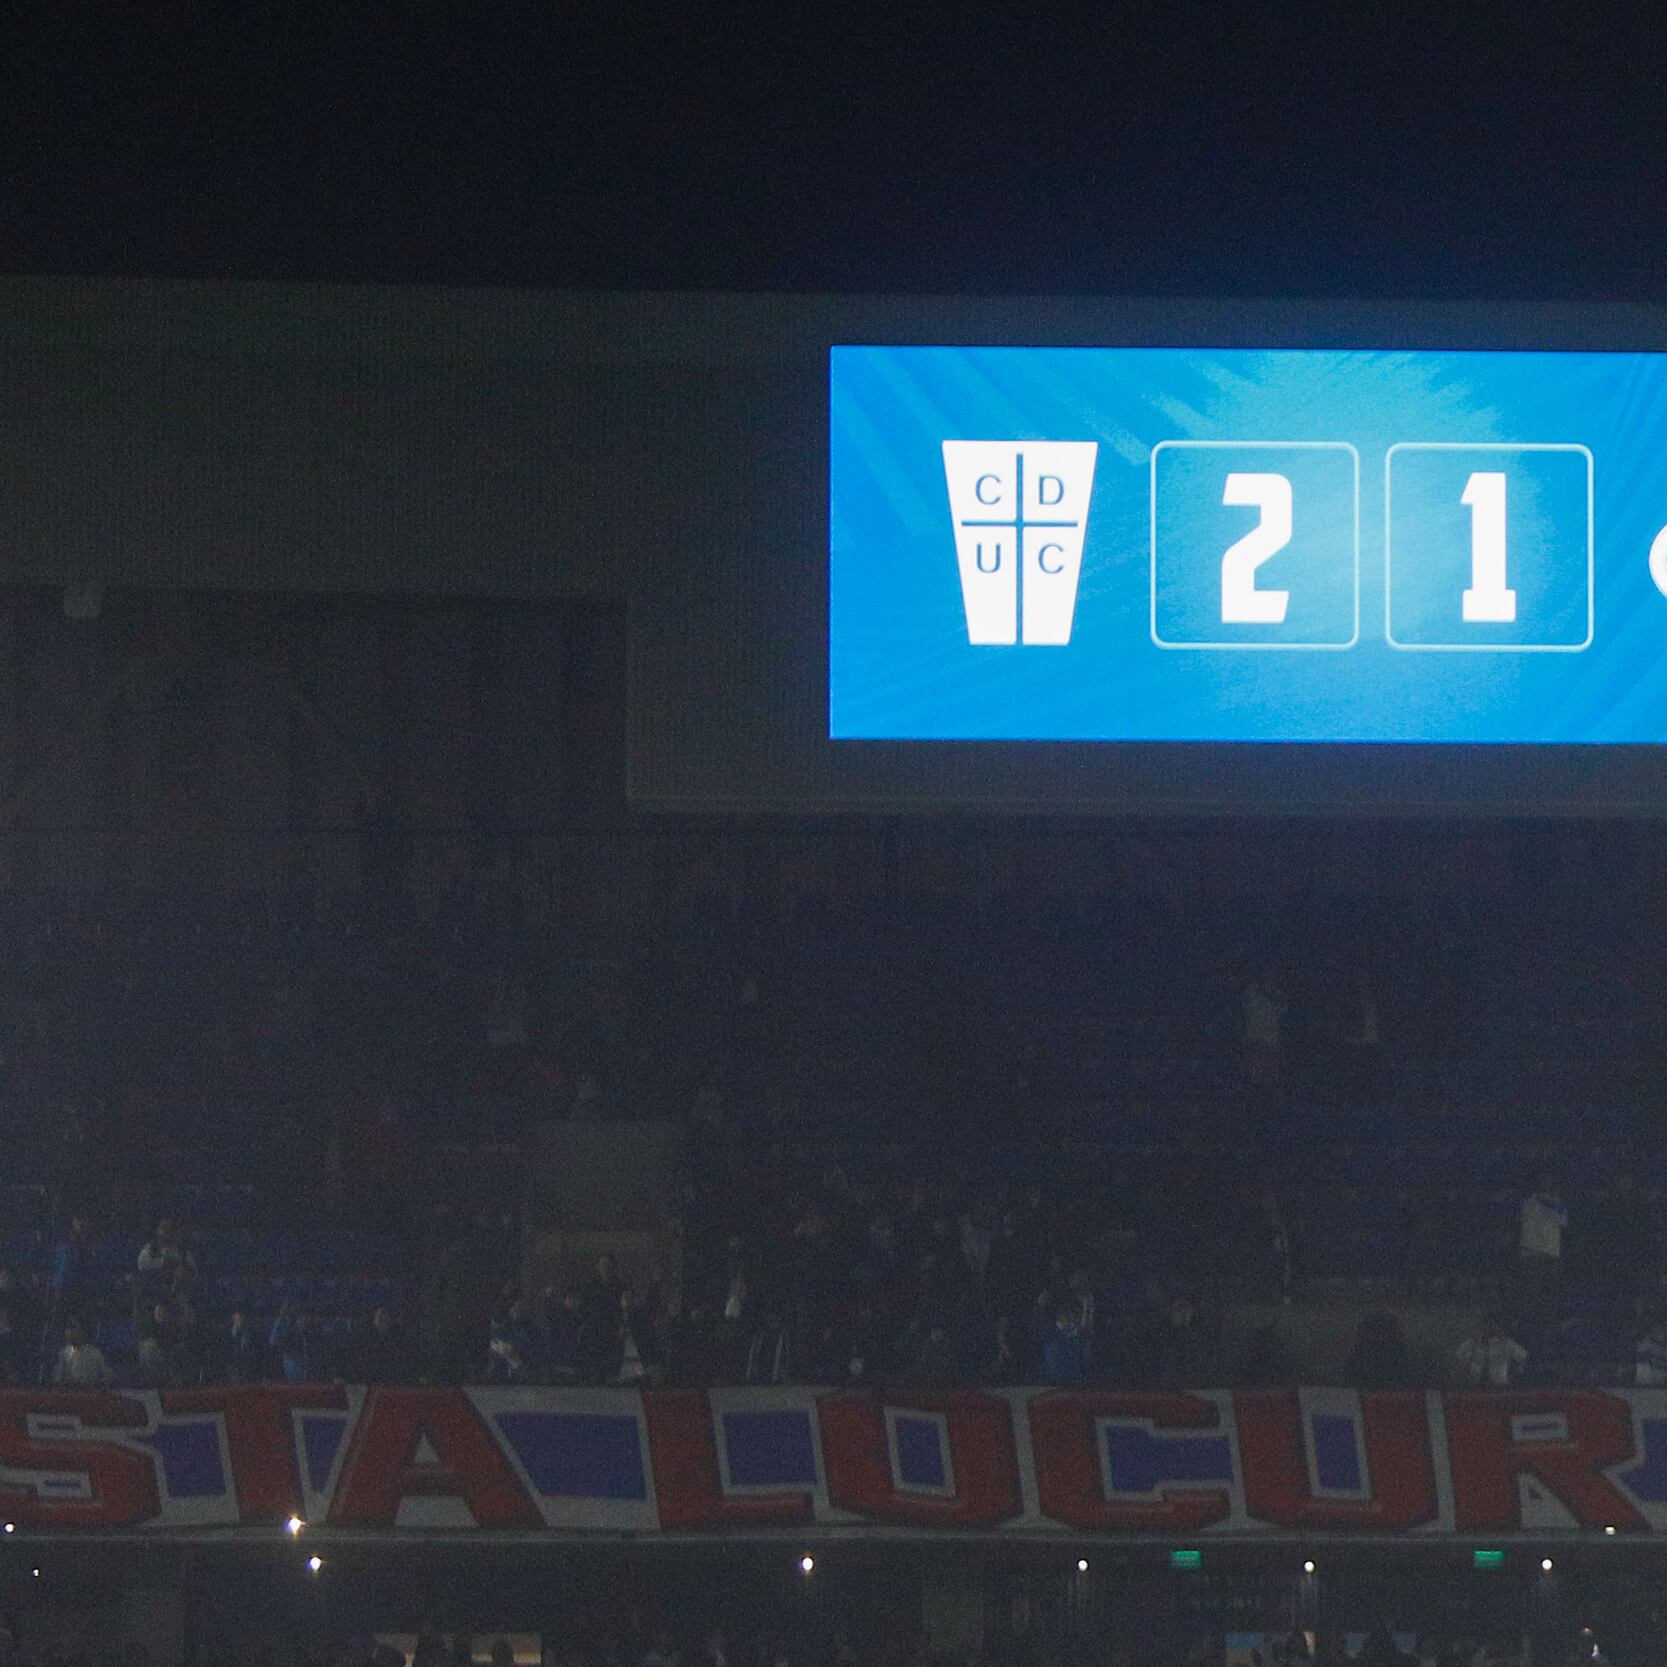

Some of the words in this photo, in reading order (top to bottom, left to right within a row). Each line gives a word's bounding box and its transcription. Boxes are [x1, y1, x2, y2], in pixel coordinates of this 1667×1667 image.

[974, 474, 1001, 507] C
[1038, 475, 1065, 506] D
[975, 543, 1001, 575] U
[1037, 543, 1065, 576] C
[1220, 472, 1293, 624] 2
[1460, 471, 1517, 623] 1
[0, 1386, 545, 1527] STA
